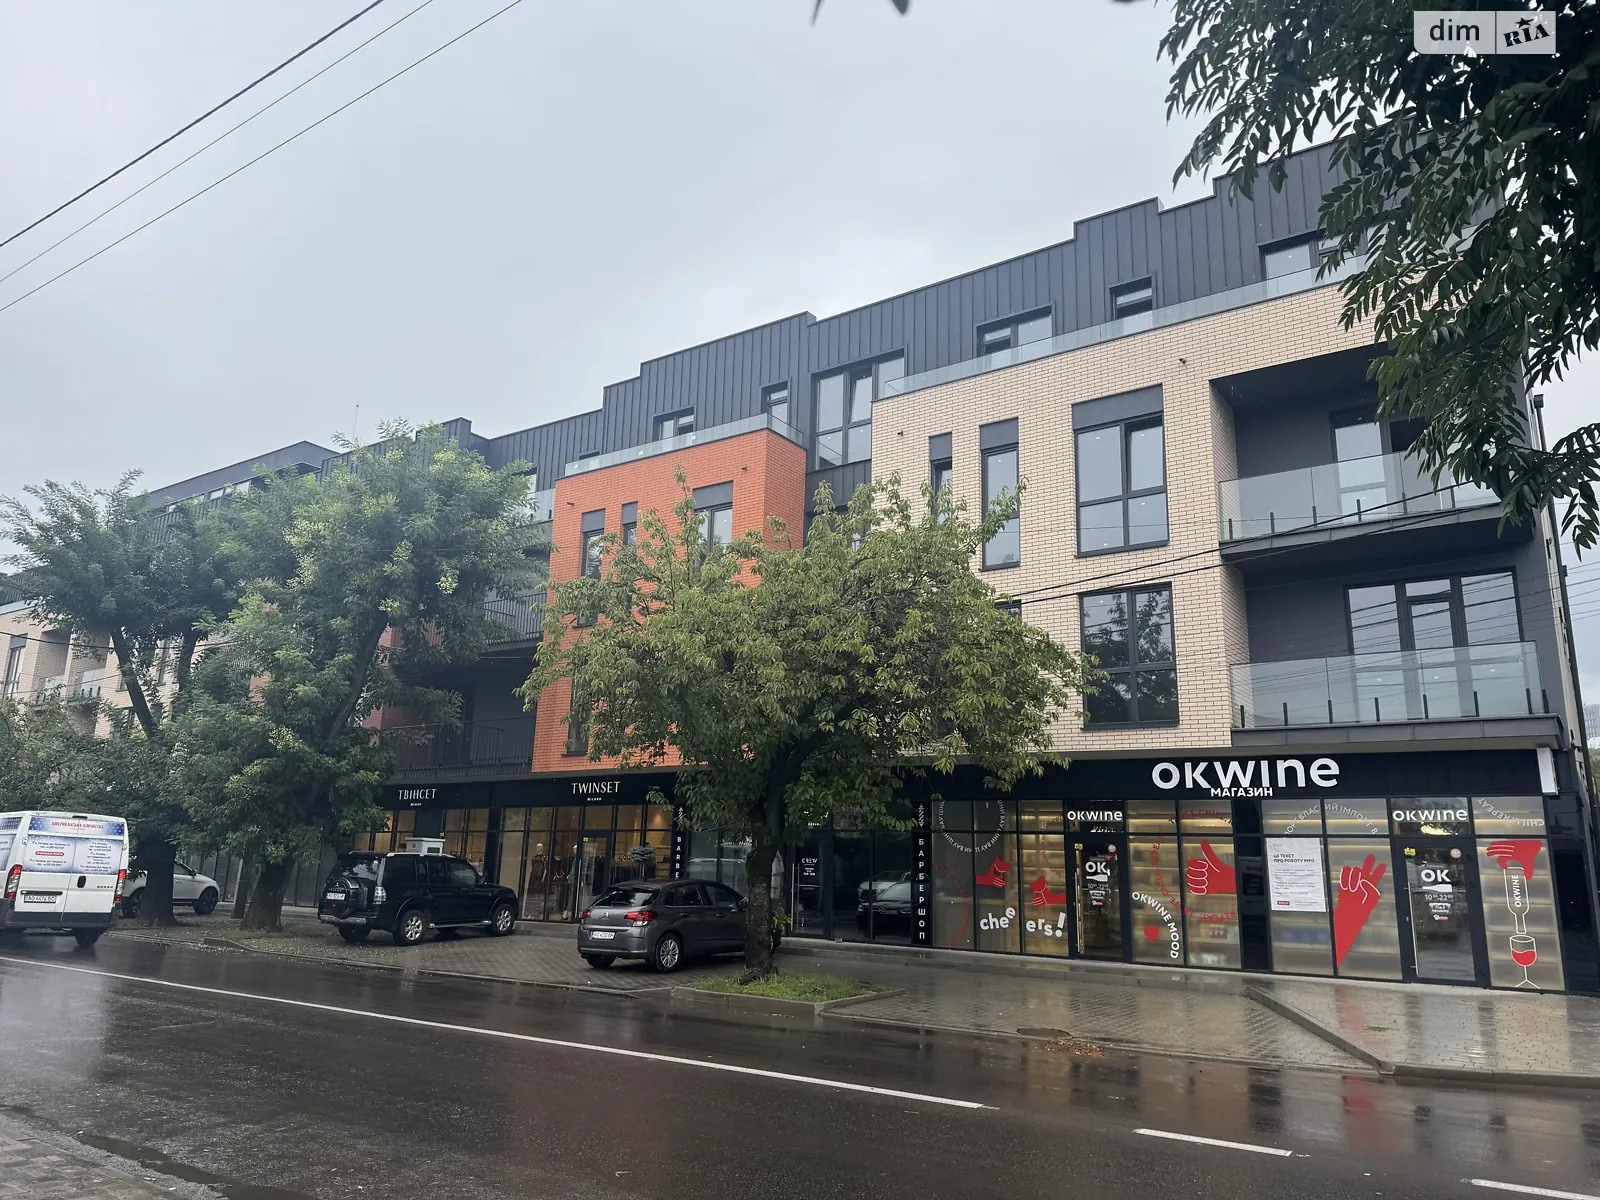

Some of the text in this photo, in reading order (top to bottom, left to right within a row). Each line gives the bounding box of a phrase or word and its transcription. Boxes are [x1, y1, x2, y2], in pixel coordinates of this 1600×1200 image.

[398, 788, 437, 800] ТВІНСЕТ
[571, 781, 621, 794] TWINSET
[1211, 787, 1273, 798] МАГАЗИН
[1085, 861, 1108, 873] OK
[1421, 869, 1451, 882] OK
[918, 838, 926, 939] БАРБЕРШОП
[1512, 874, 1522, 908] OKWINE
[1131, 891, 1180, 959] OKWINE MOOD
